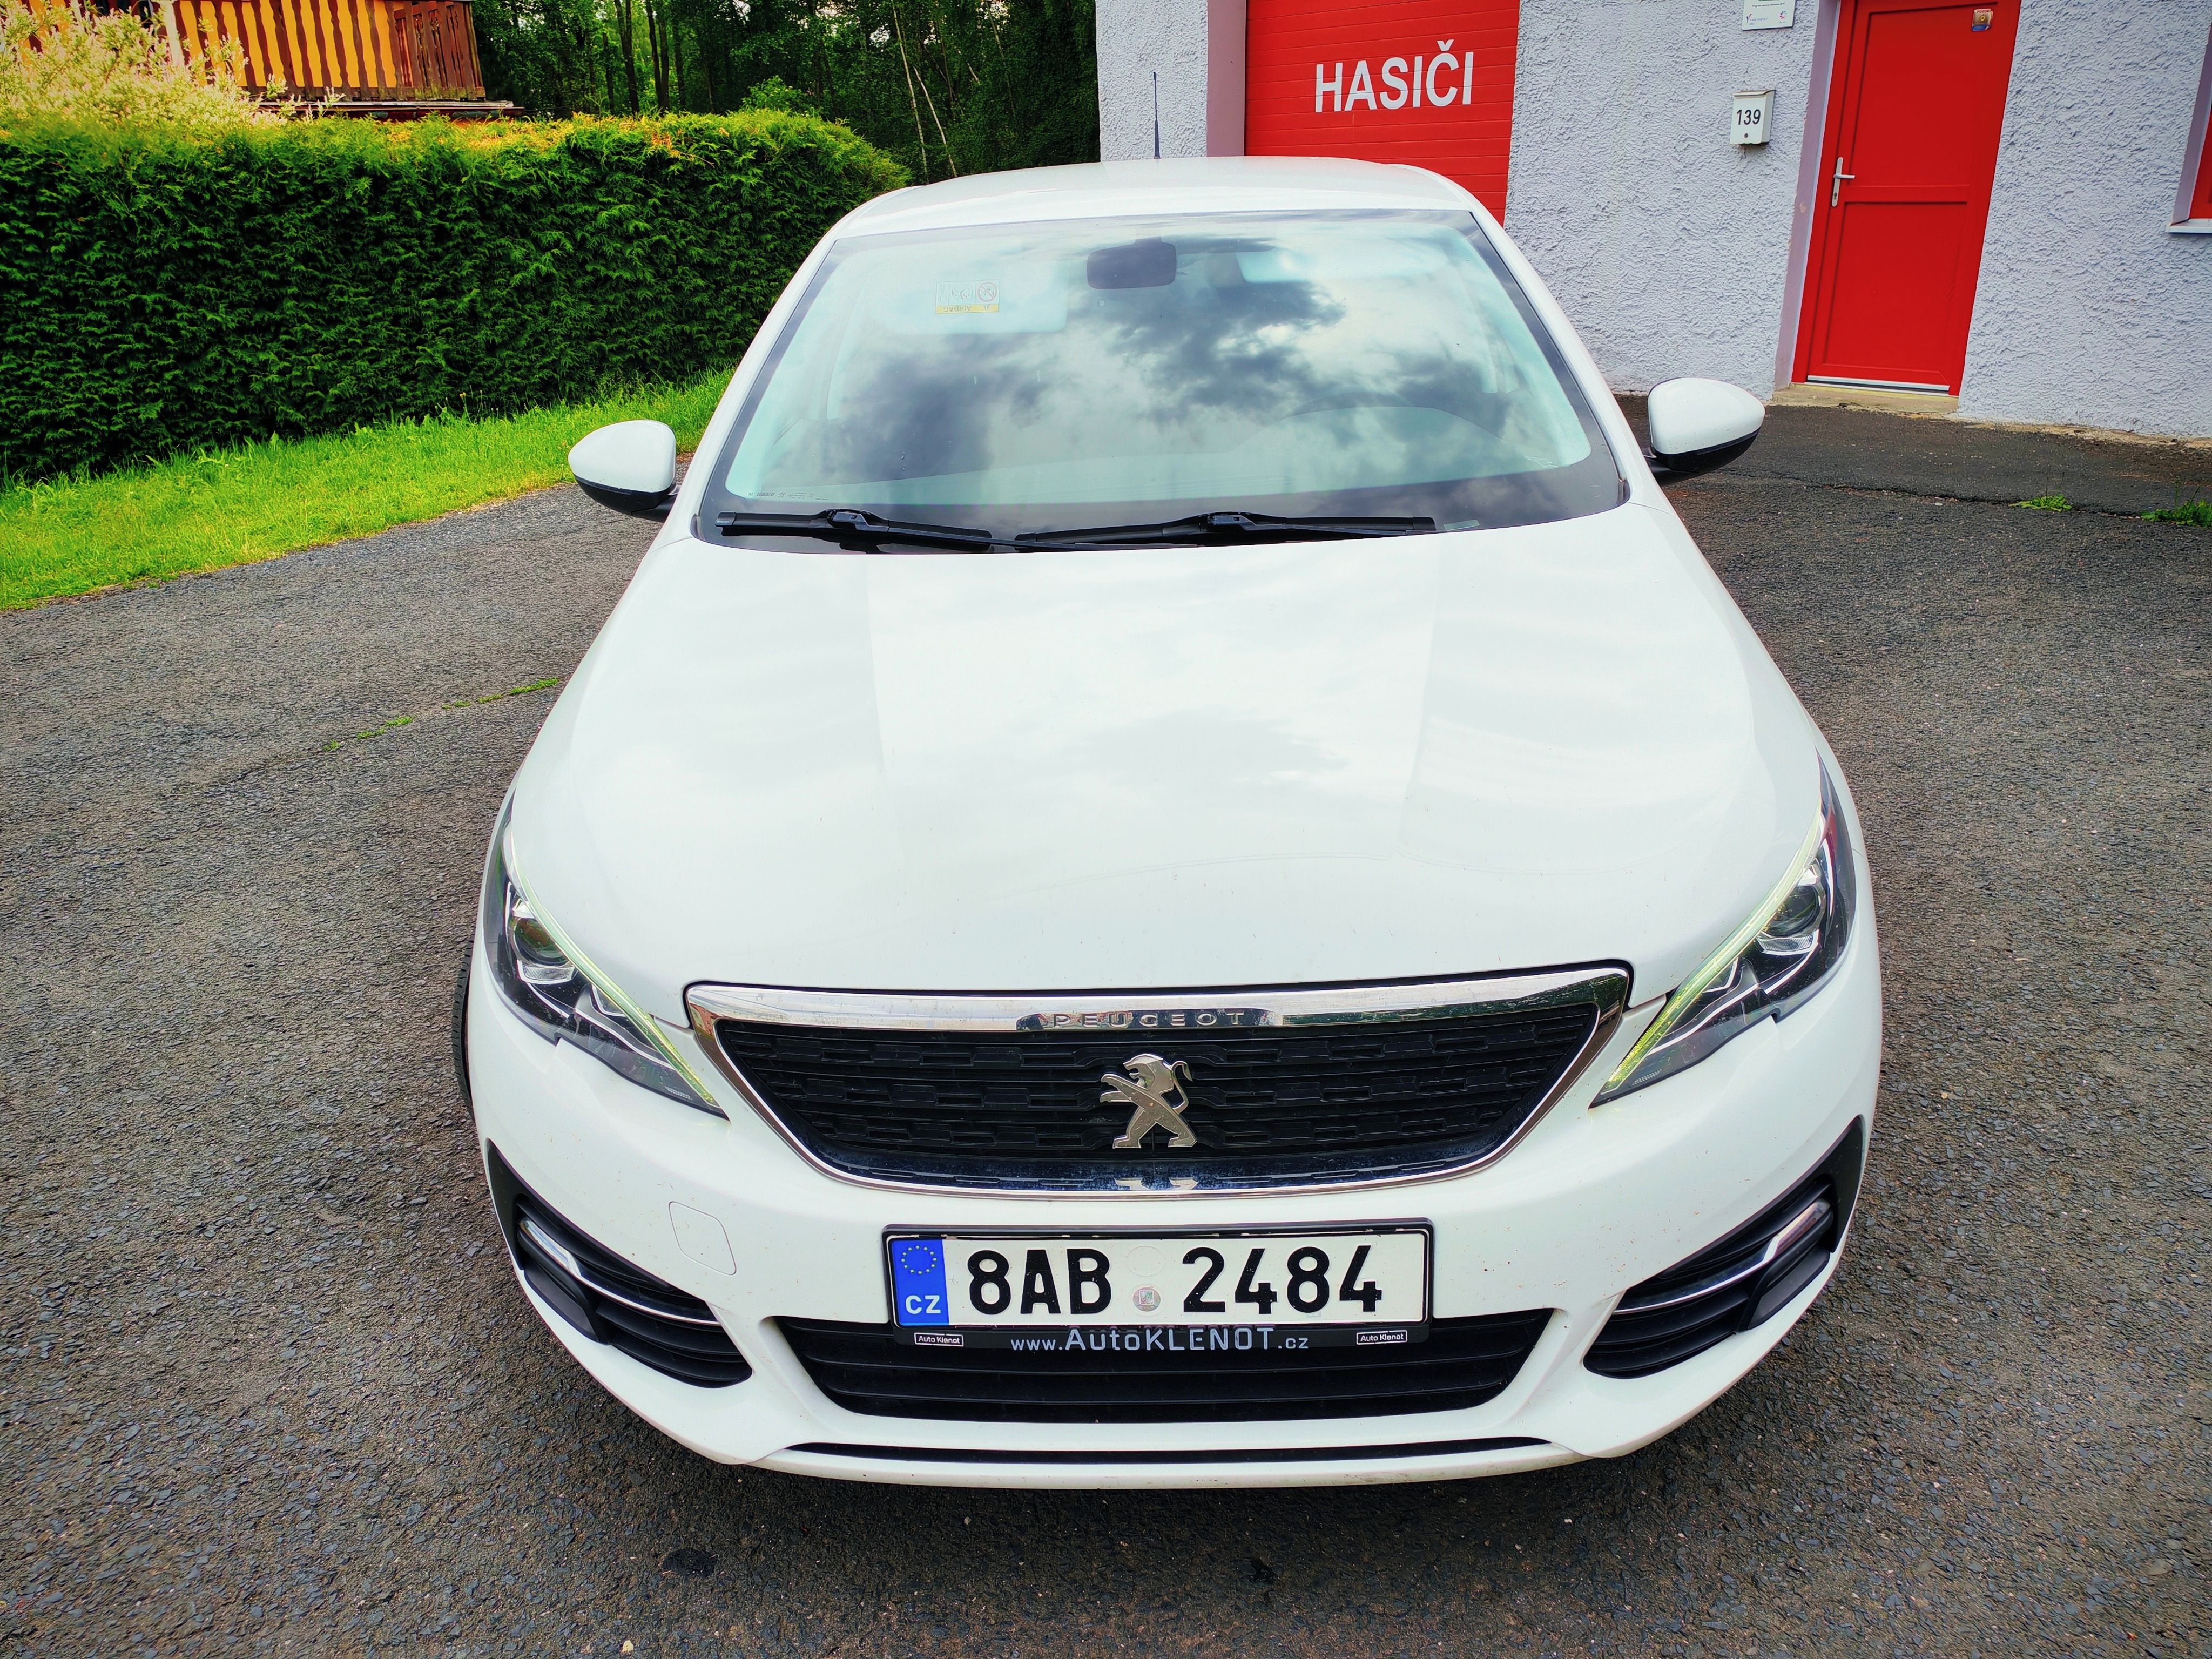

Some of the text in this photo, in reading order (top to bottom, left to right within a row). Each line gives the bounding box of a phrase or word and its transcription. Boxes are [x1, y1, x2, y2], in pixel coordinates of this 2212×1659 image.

[1315, 39, 1474, 113] HASIČI
[1736, 109, 1761, 125] 139
[1053, 1013, 1244, 1028] PEUGEOT
[967, 1245, 1382, 1315] 8AB 2484
[905, 1295, 941, 1314] CZ
[1010, 1328, 1309, 1351] www.AutoKLENOT.cz
